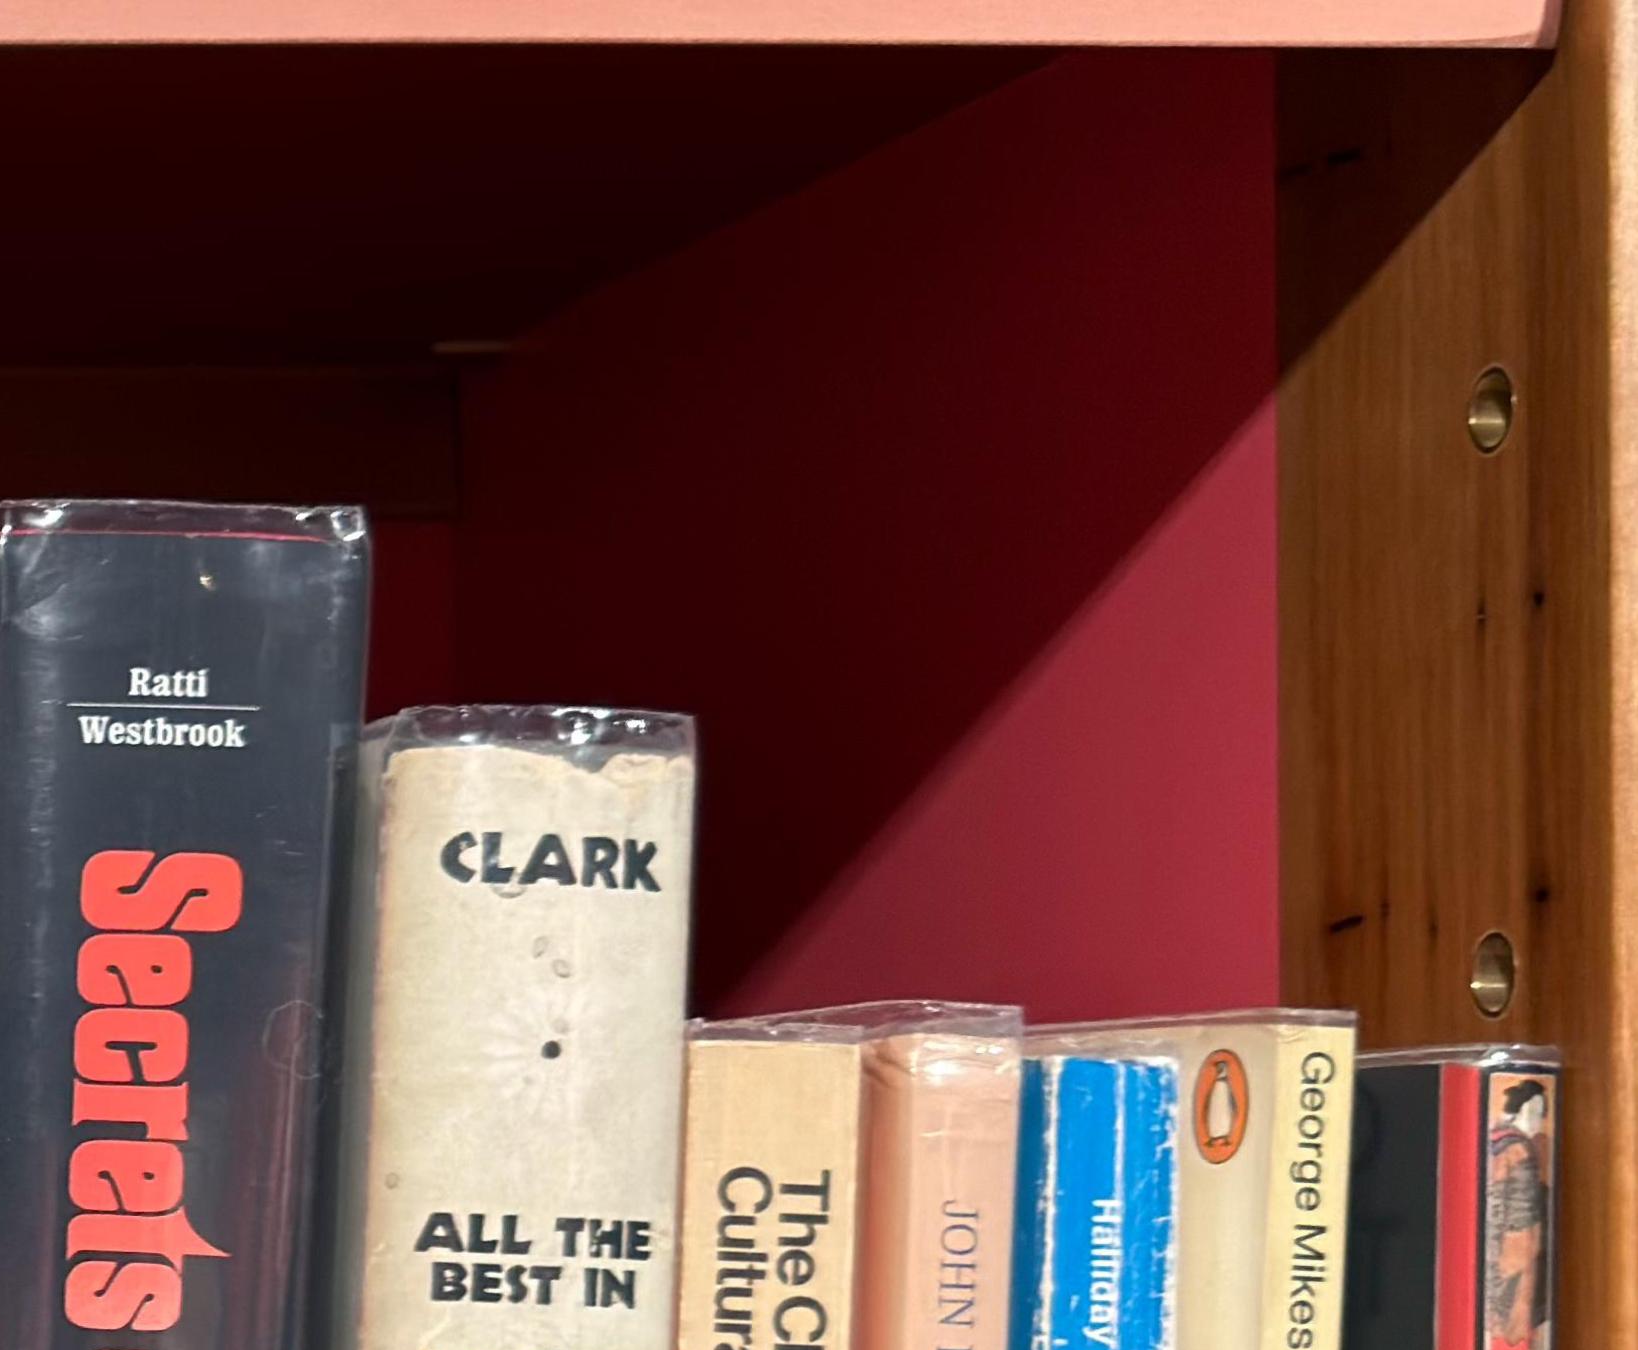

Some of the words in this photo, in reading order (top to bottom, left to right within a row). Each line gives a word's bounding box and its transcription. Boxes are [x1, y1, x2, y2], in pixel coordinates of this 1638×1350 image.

[128, 667, 207, 699] Ratti
[78, 714, 246, 749] Westbrook
[440, 831, 662, 893] CLARK
[64, 850, 244, 1332] Secrets
[1288, 1050, 1336, 1214] George
[415, 1212, 532, 1254] ALL
[555, 1217, 652, 1260] THE
[776, 1168, 833, 1285] The
[938, 1199, 979, 1328] JOHN
[431, 1262, 562, 1303] BEST
[585, 1267, 635, 1309] IN
[1081, 1198, 1124, 1347] Halliday
